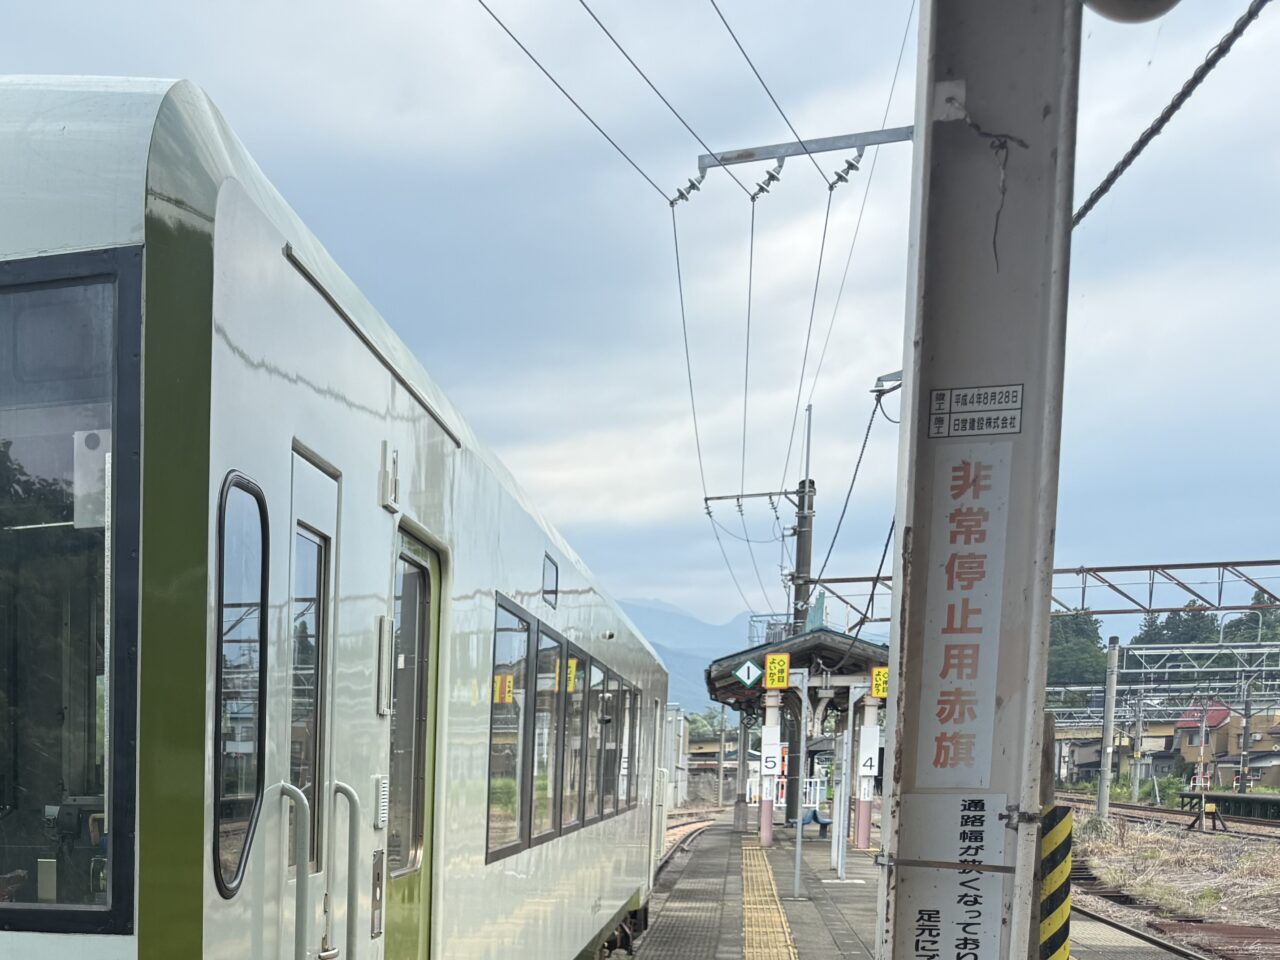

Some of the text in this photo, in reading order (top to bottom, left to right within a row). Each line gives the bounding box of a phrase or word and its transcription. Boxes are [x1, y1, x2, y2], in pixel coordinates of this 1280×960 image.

[954, 389, 1019, 407] 平成4年8月28日
[931, 460, 993, 769] 非常停止用赤旗
[764, 756, 777, 769] 5
[862, 757, 875, 770] 4
